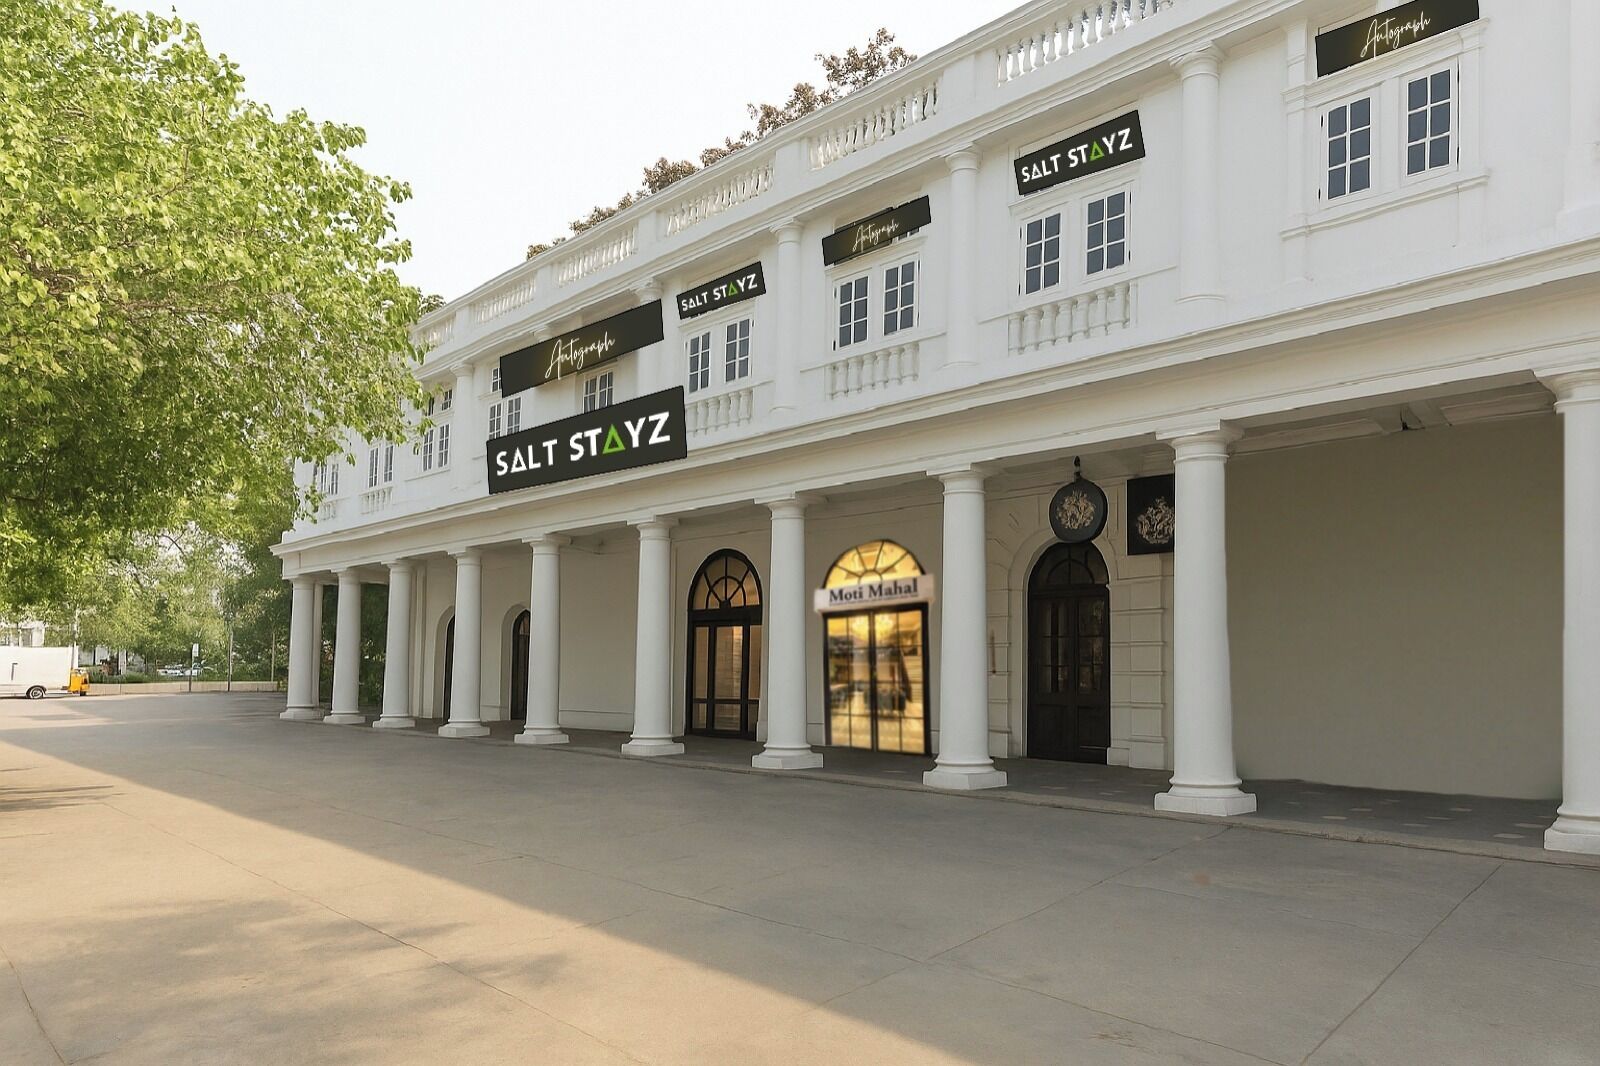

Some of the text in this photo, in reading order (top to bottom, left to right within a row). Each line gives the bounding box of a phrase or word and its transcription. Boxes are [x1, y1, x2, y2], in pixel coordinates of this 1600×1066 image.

[1360, 11, 1431, 59] Autograph
[1021, 127, 1133, 183] SALT STAYZ
[852, 219, 900, 253] Autograph
[681, 273, 758, 312] SALT STAYZ
[545, 331, 616, 380] Autograph
[496, 411, 671, 477] SALT STAYZ
[829, 586, 863, 603] Moti
[868, 578, 918, 599] Mahal
